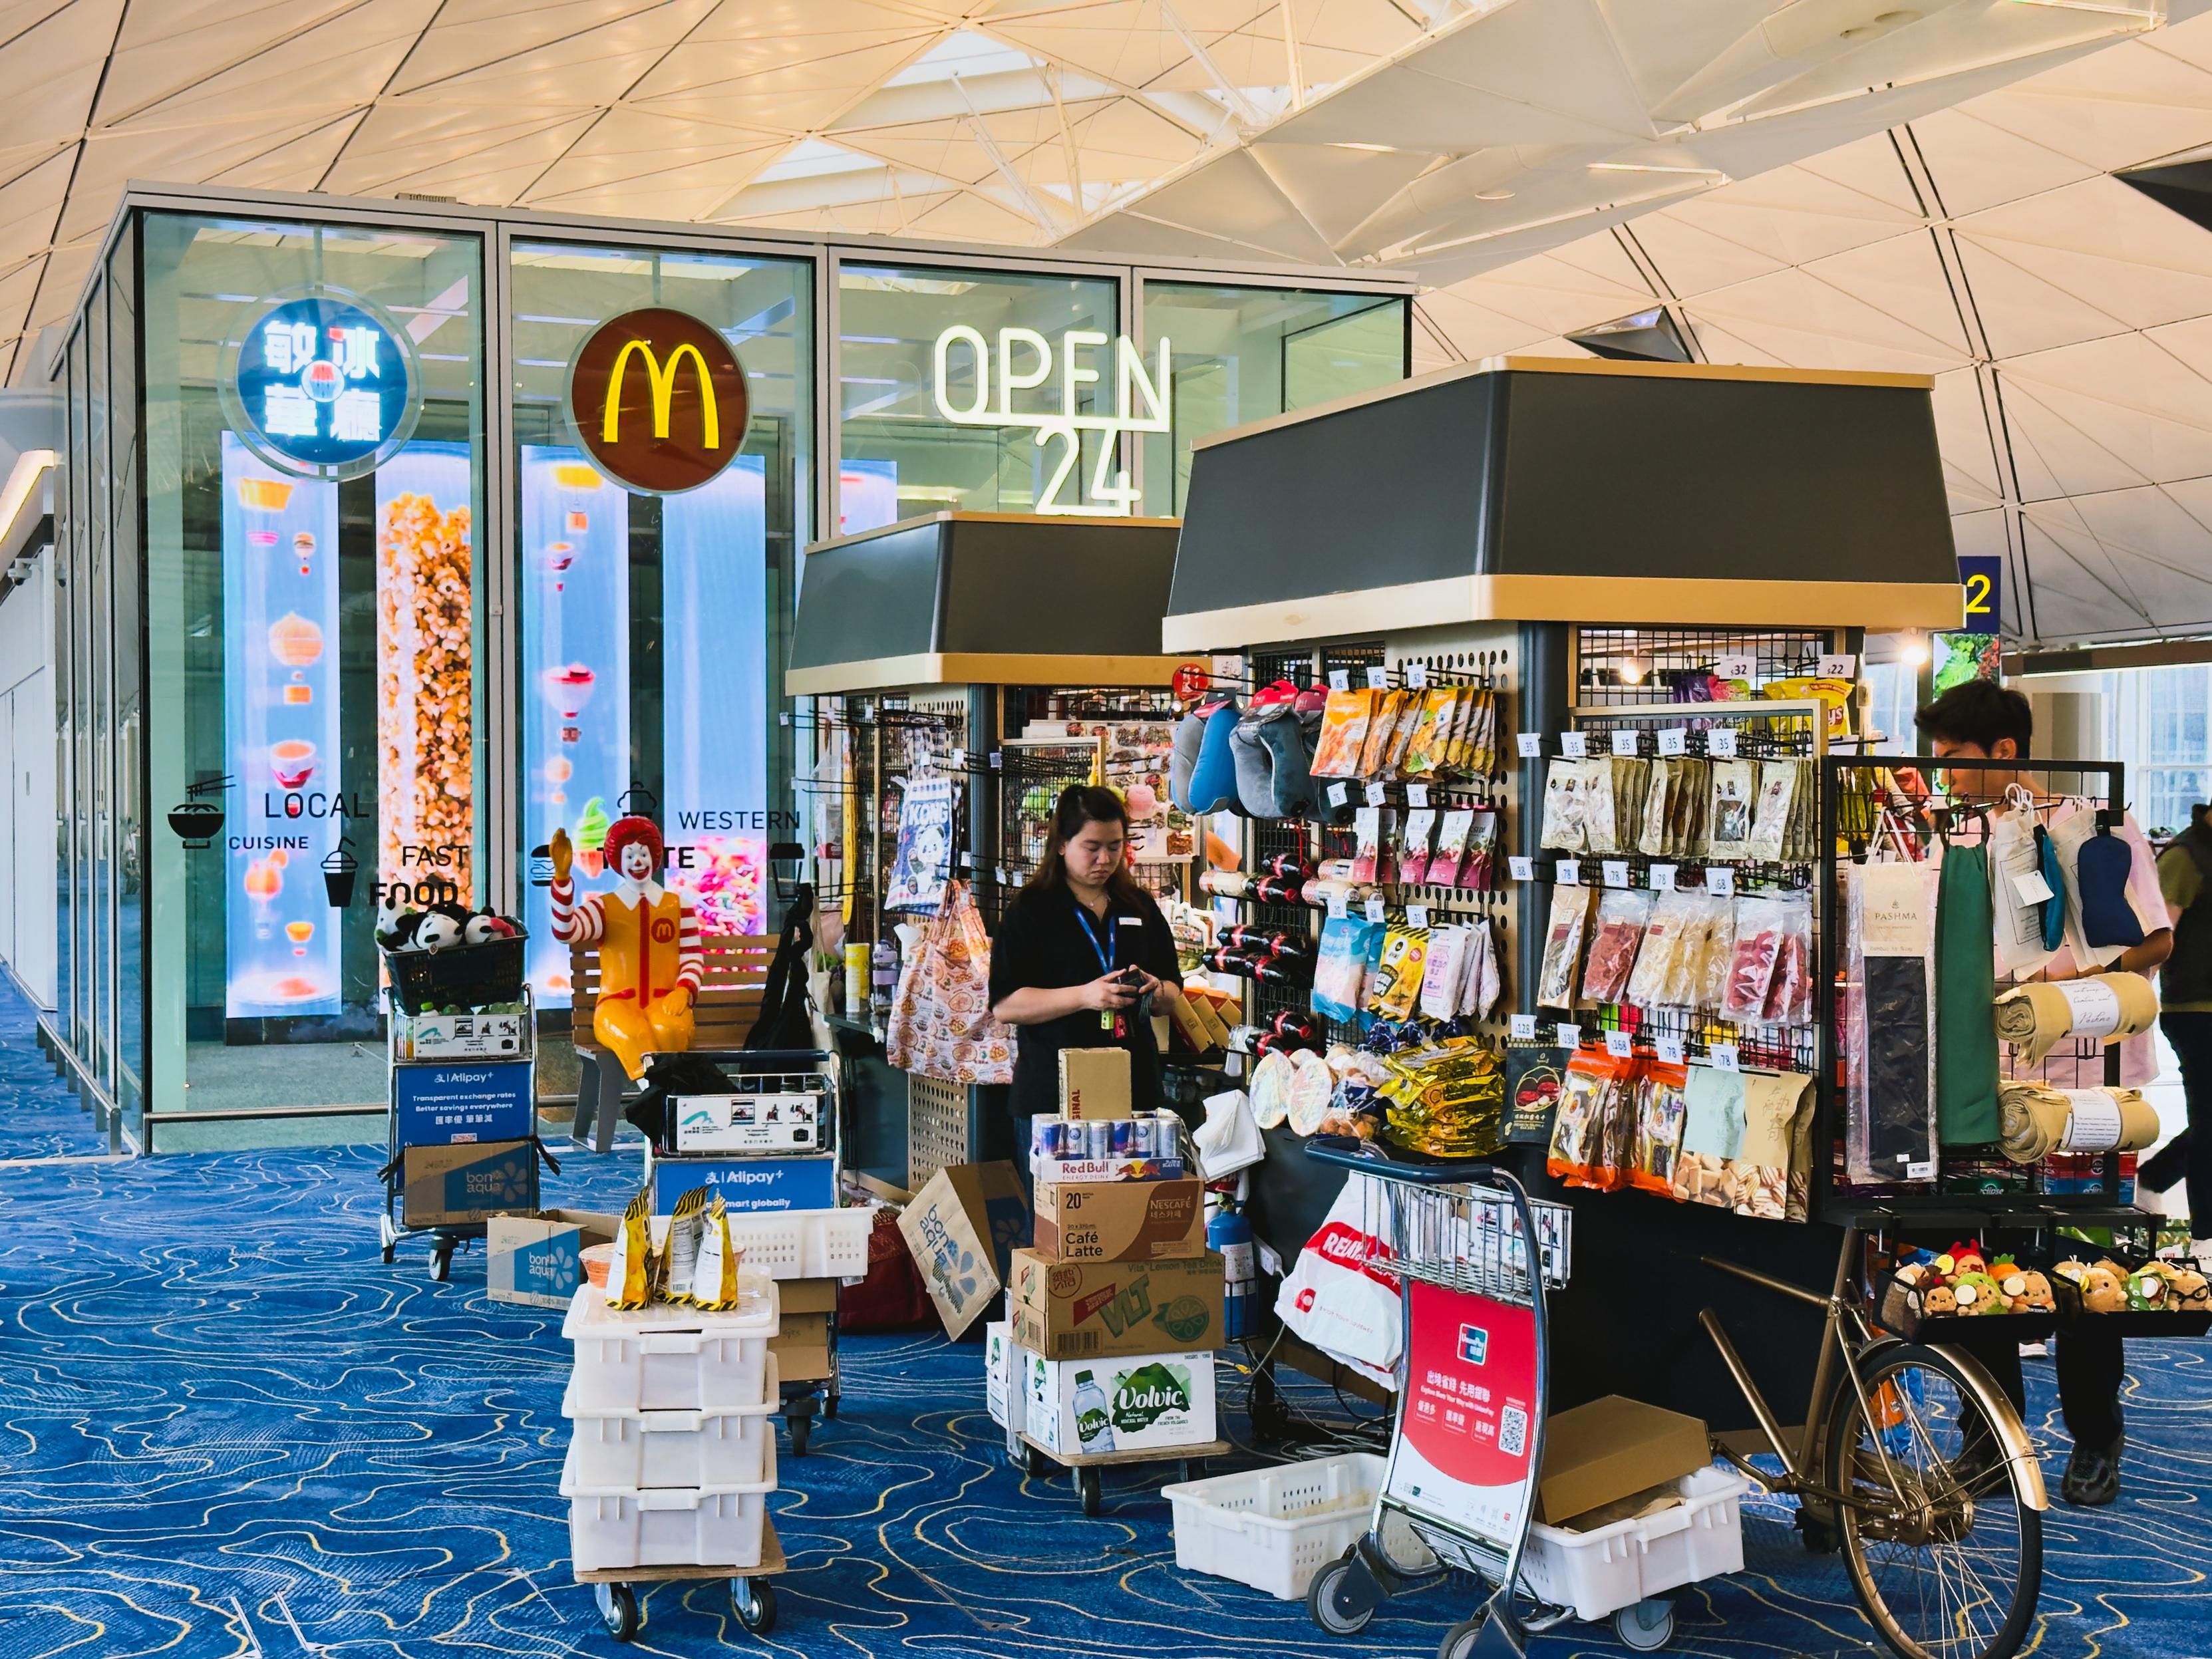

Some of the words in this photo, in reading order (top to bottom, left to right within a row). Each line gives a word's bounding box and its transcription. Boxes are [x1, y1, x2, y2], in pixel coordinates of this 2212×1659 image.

[934, 325, 1171, 432] OPEN
[1035, 426, 1142, 517] 24
[1967, 574, 1990, 613] 2
[1730, 665, 1747, 676] $32
[1827, 665, 1843, 675] $22
[265, 793, 370, 818] LOCAL
[909, 801, 949, 826] KONG
[679, 811, 801, 830] WESTERN
[229, 836, 309, 849] CUISINE
[402, 845, 468, 867] FAST
[596, 847, 695, 869] TTE
[369, 881, 459, 906] FOOD
[1062, 1163, 1085, 1173] Red
[1088, 1162, 1109, 1173] Bull
[466, 1171, 492, 1183] bon
[466, 1183, 503, 1195] aqua
[724, 1199, 750, 1208] mart
[751, 1197, 791, 1209] globally
[1066, 1192, 1082, 1209] 20
[928, 1203, 949, 1248] bon
[1066, 1231, 1098, 1245] Café
[529, 1251, 548, 1265] bon
[1066, 1245, 1103, 1258] Latte
[529, 1265, 555, 1278] aqua
[1119, 1385, 1184, 1410] Volvic
[1079, 1416, 1109, 1433] Volvic
